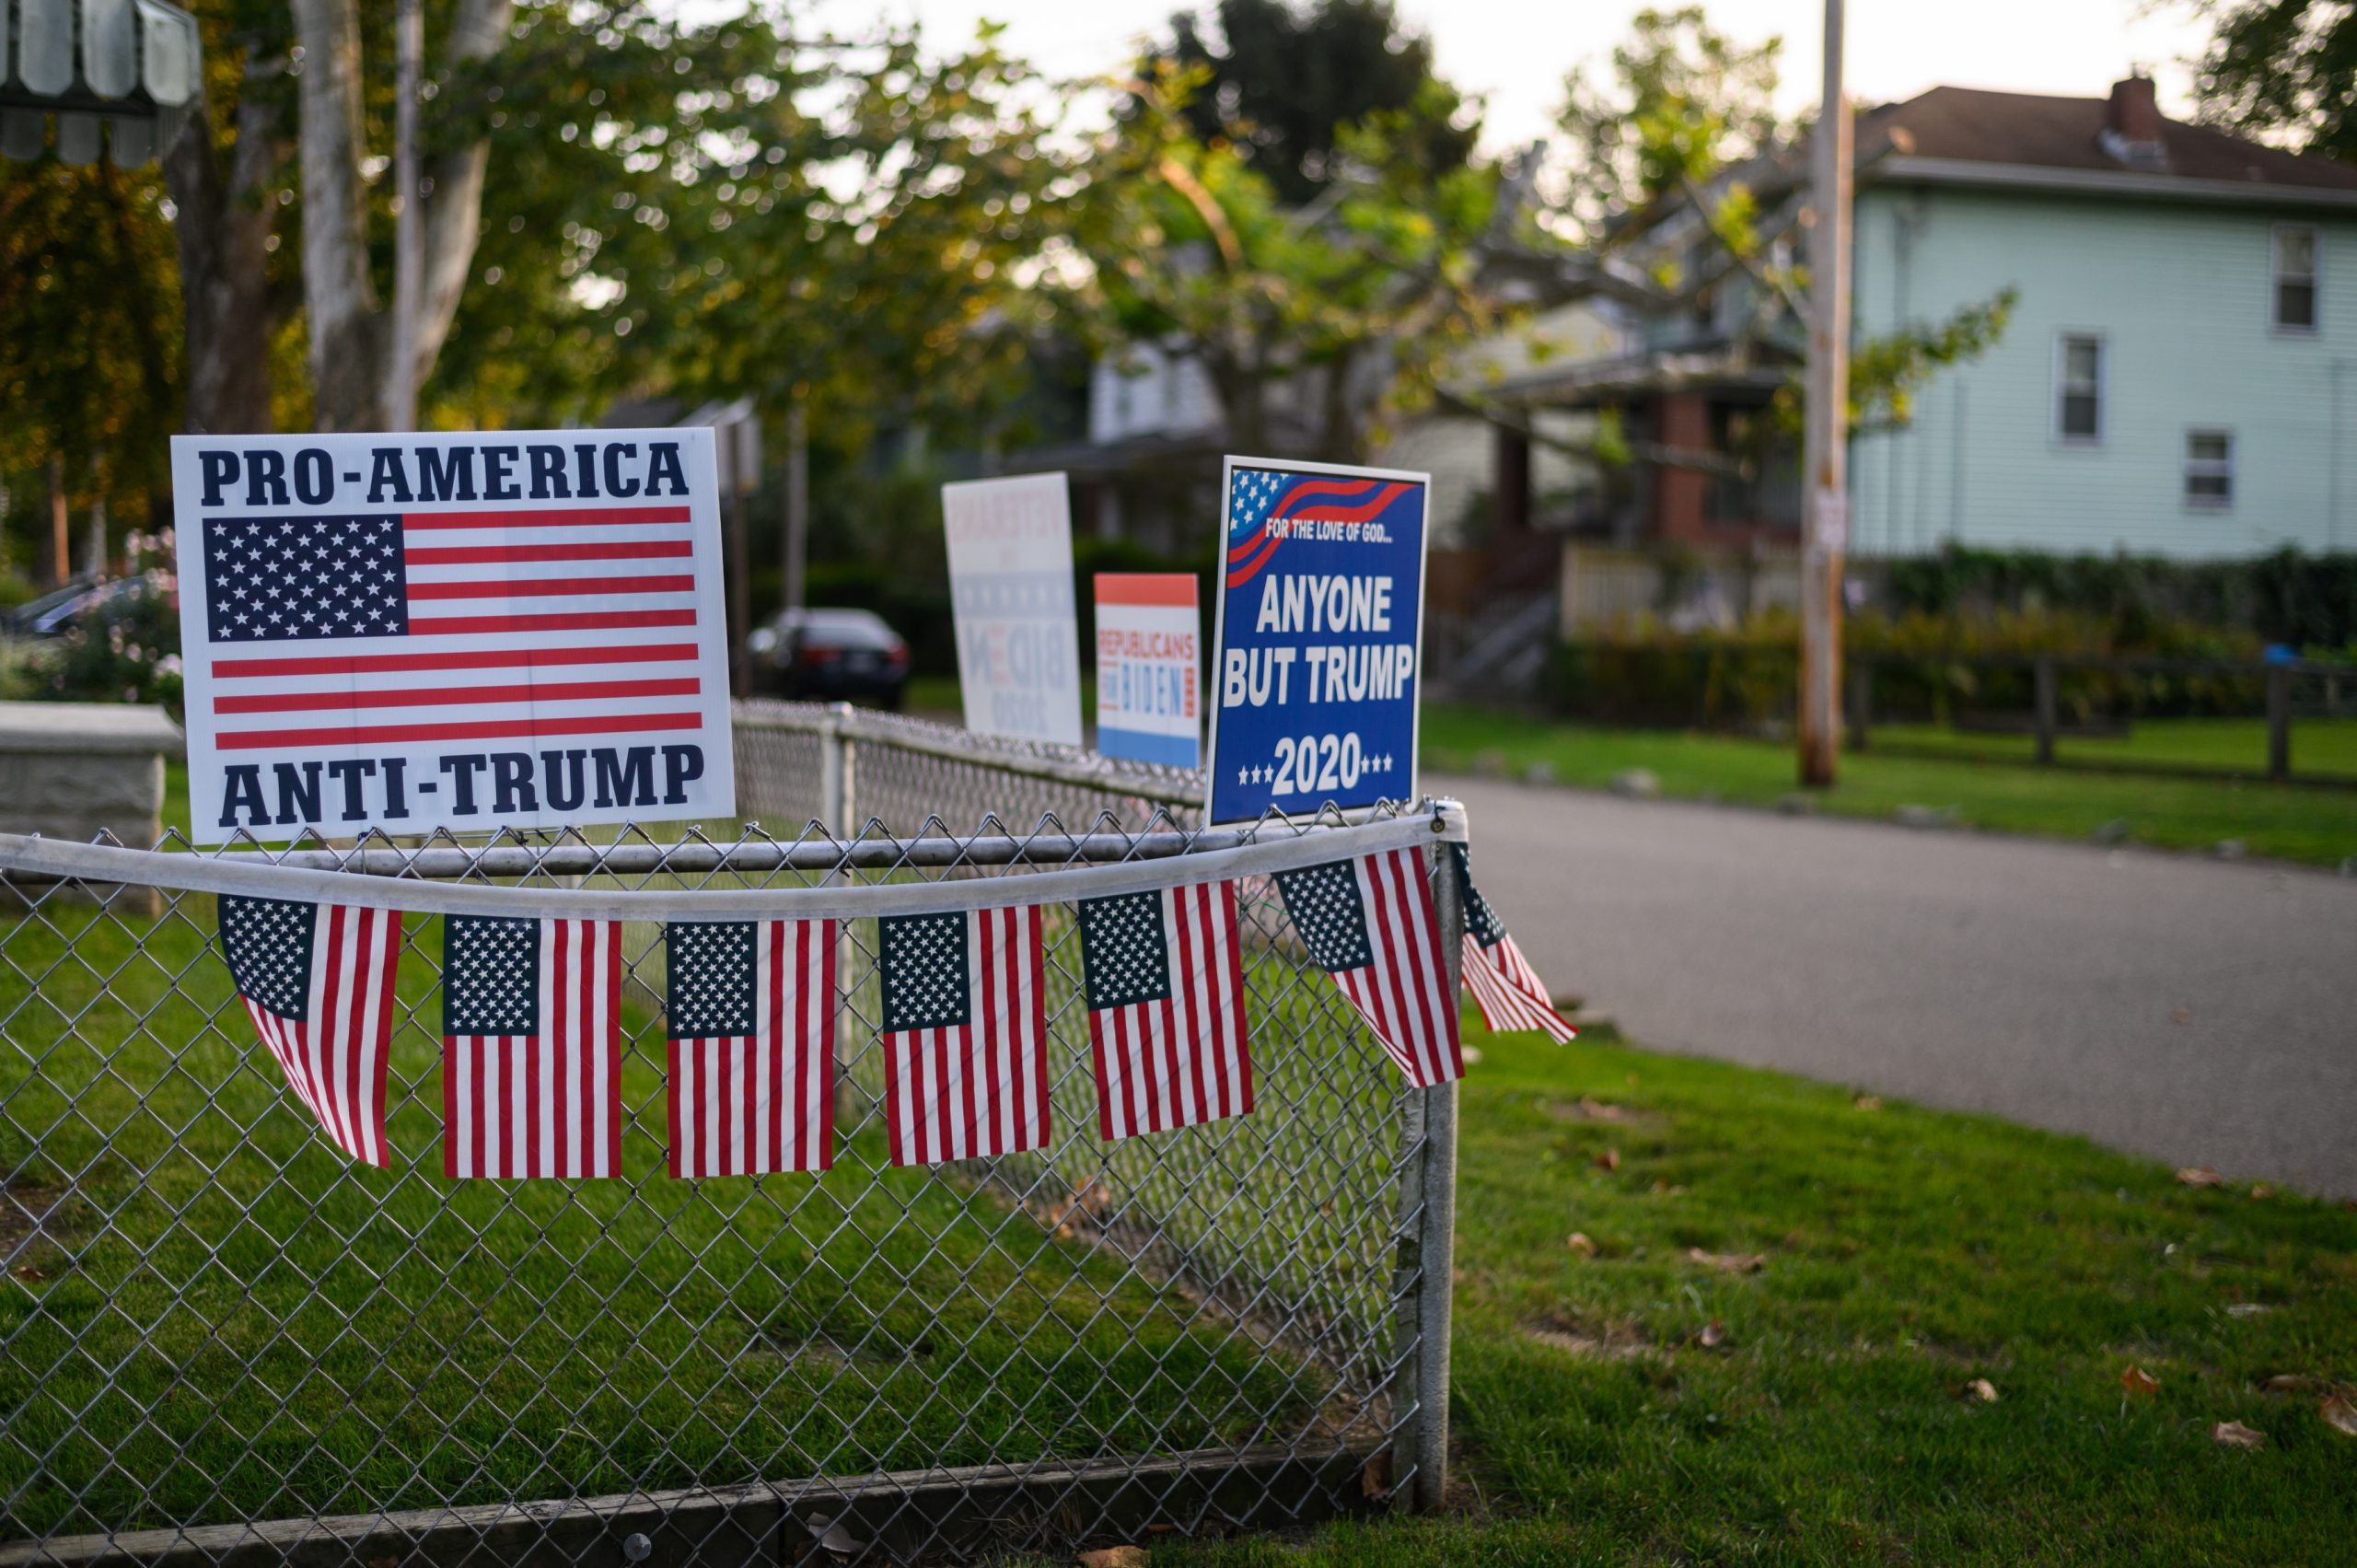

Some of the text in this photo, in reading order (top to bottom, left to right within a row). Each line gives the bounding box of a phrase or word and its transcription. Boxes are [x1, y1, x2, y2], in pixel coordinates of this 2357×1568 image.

[198, 442, 690, 507] PRO-AMERICA
[1265, 517, 1393, 544] FOR THE LOVE OF GOD...
[1255, 574, 1394, 633] ANYONE
[1098, 629, 1195, 661] REPUBLICANS
[1122, 662, 1182, 717] BIDEN
[1223, 647, 1297, 708] BUT
[1305, 644, 1414, 703] TRUMP
[217, 744, 705, 828] ANTI-TRUMP
[1271, 732, 1362, 796] 2020
